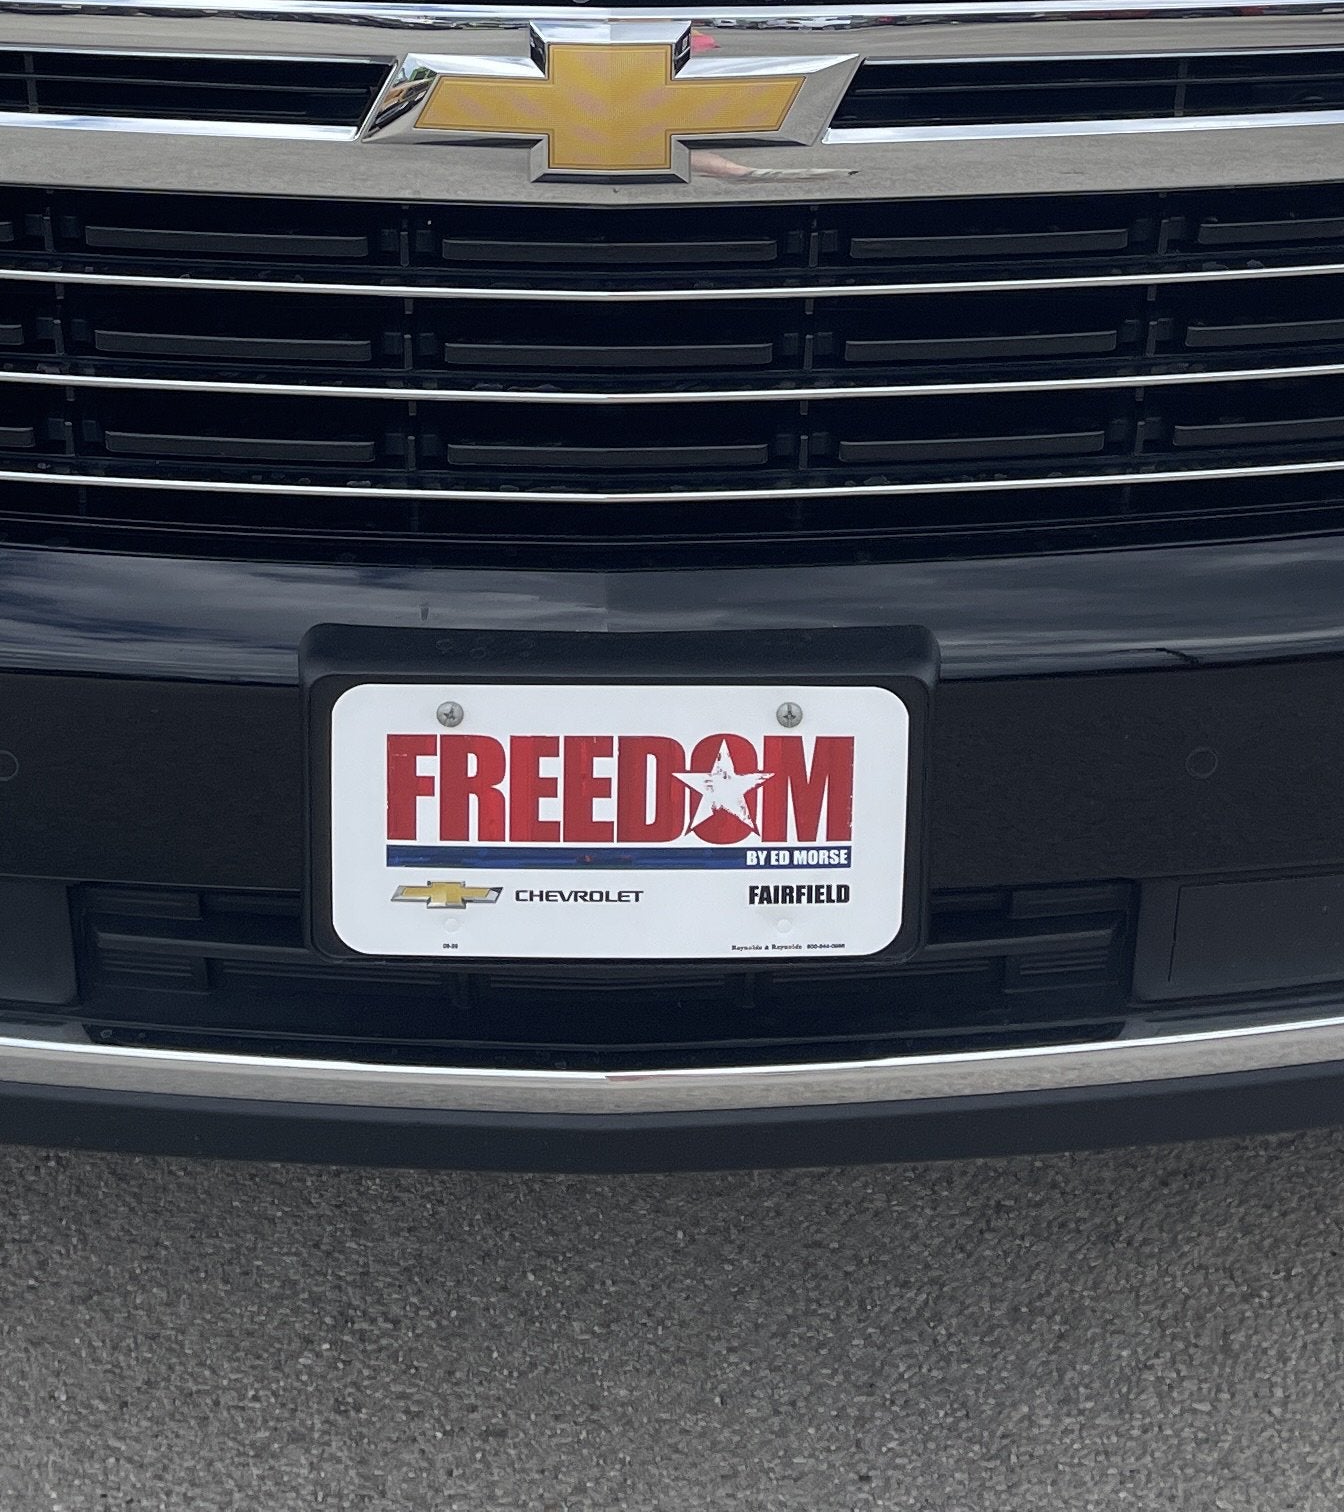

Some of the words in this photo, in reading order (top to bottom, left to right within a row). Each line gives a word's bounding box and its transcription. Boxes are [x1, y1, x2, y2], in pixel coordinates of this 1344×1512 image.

[386, 733, 855, 845] FREEDOM
[746, 850, 768, 866] BY
[770, 850, 790, 866] ED
[793, 849, 848, 865] MORSE
[515, 889, 644, 902] CHEVROLET
[748, 884, 850, 904] FAIRFIELD
